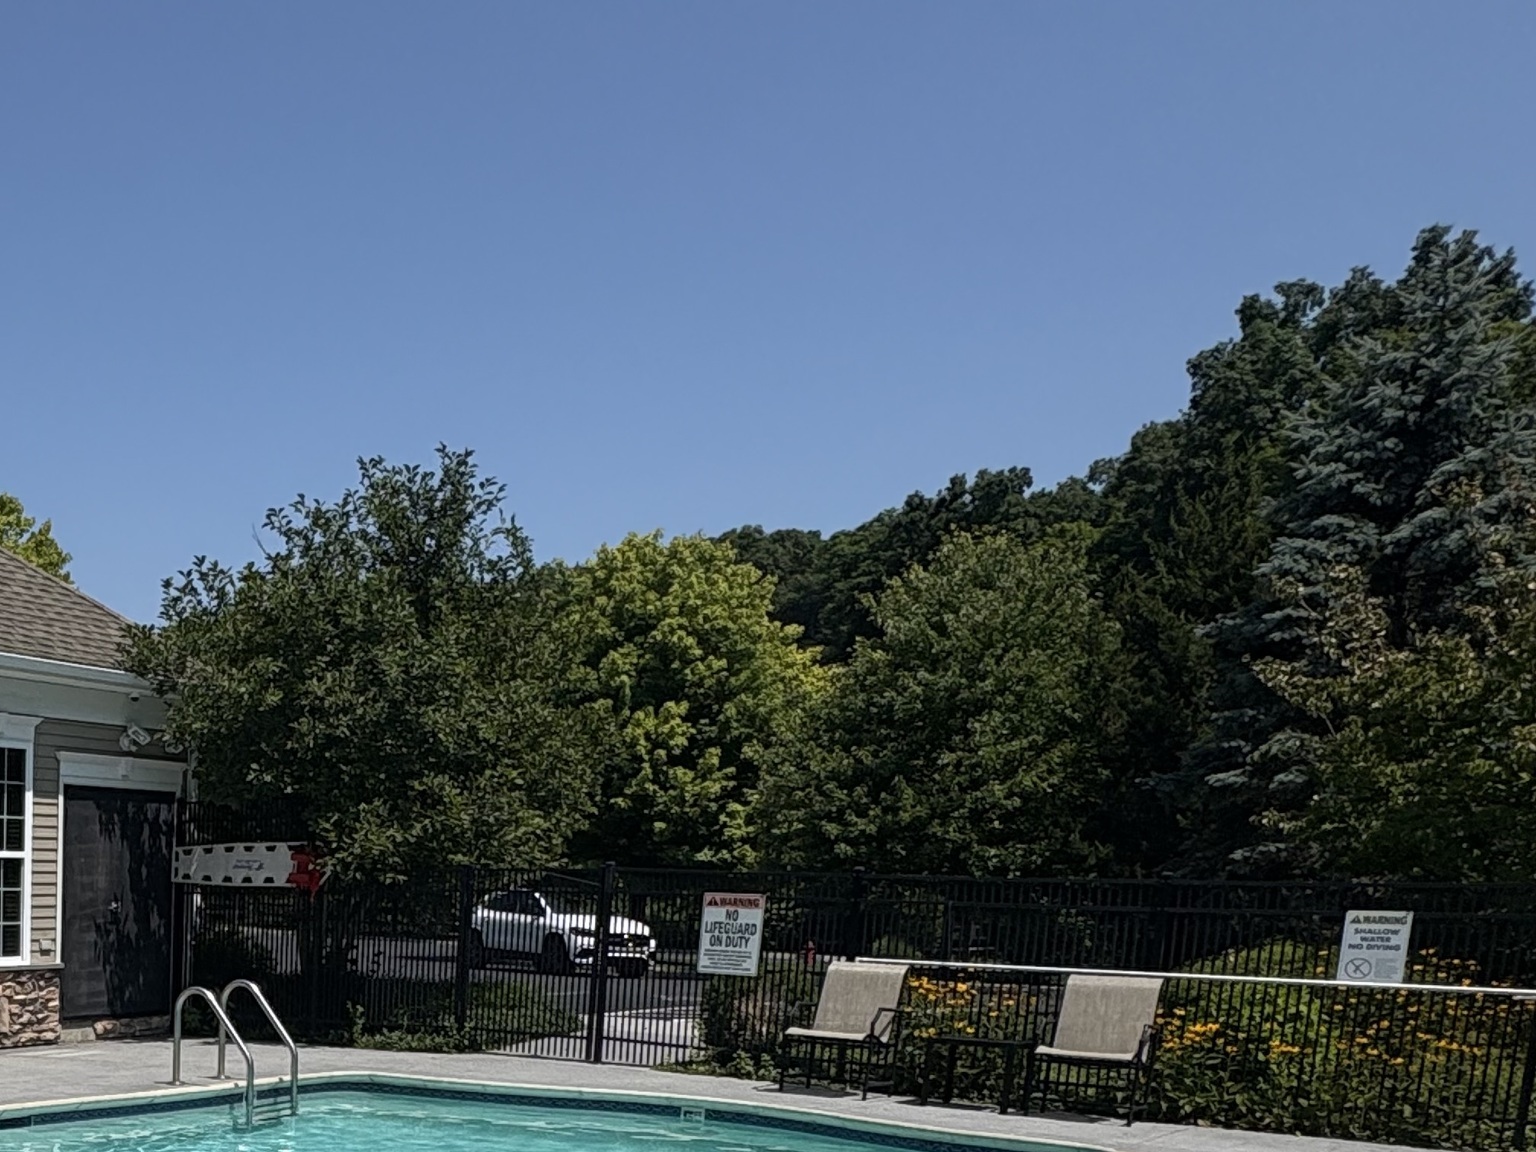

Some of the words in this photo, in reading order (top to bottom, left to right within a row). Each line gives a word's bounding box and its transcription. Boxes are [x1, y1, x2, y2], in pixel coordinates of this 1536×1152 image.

[719, 897, 761, 907] WARNING
[725, 909, 739, 921] NO
[1363, 915, 1408, 925] WARNING
[704, 921, 758, 936] LIFEGUARD
[1354, 927, 1401, 936] SHALLOW
[709, 934, 723, 947] ON
[724, 936, 751, 949] DUTY
[1365, 943, 1402, 951] DIVING
